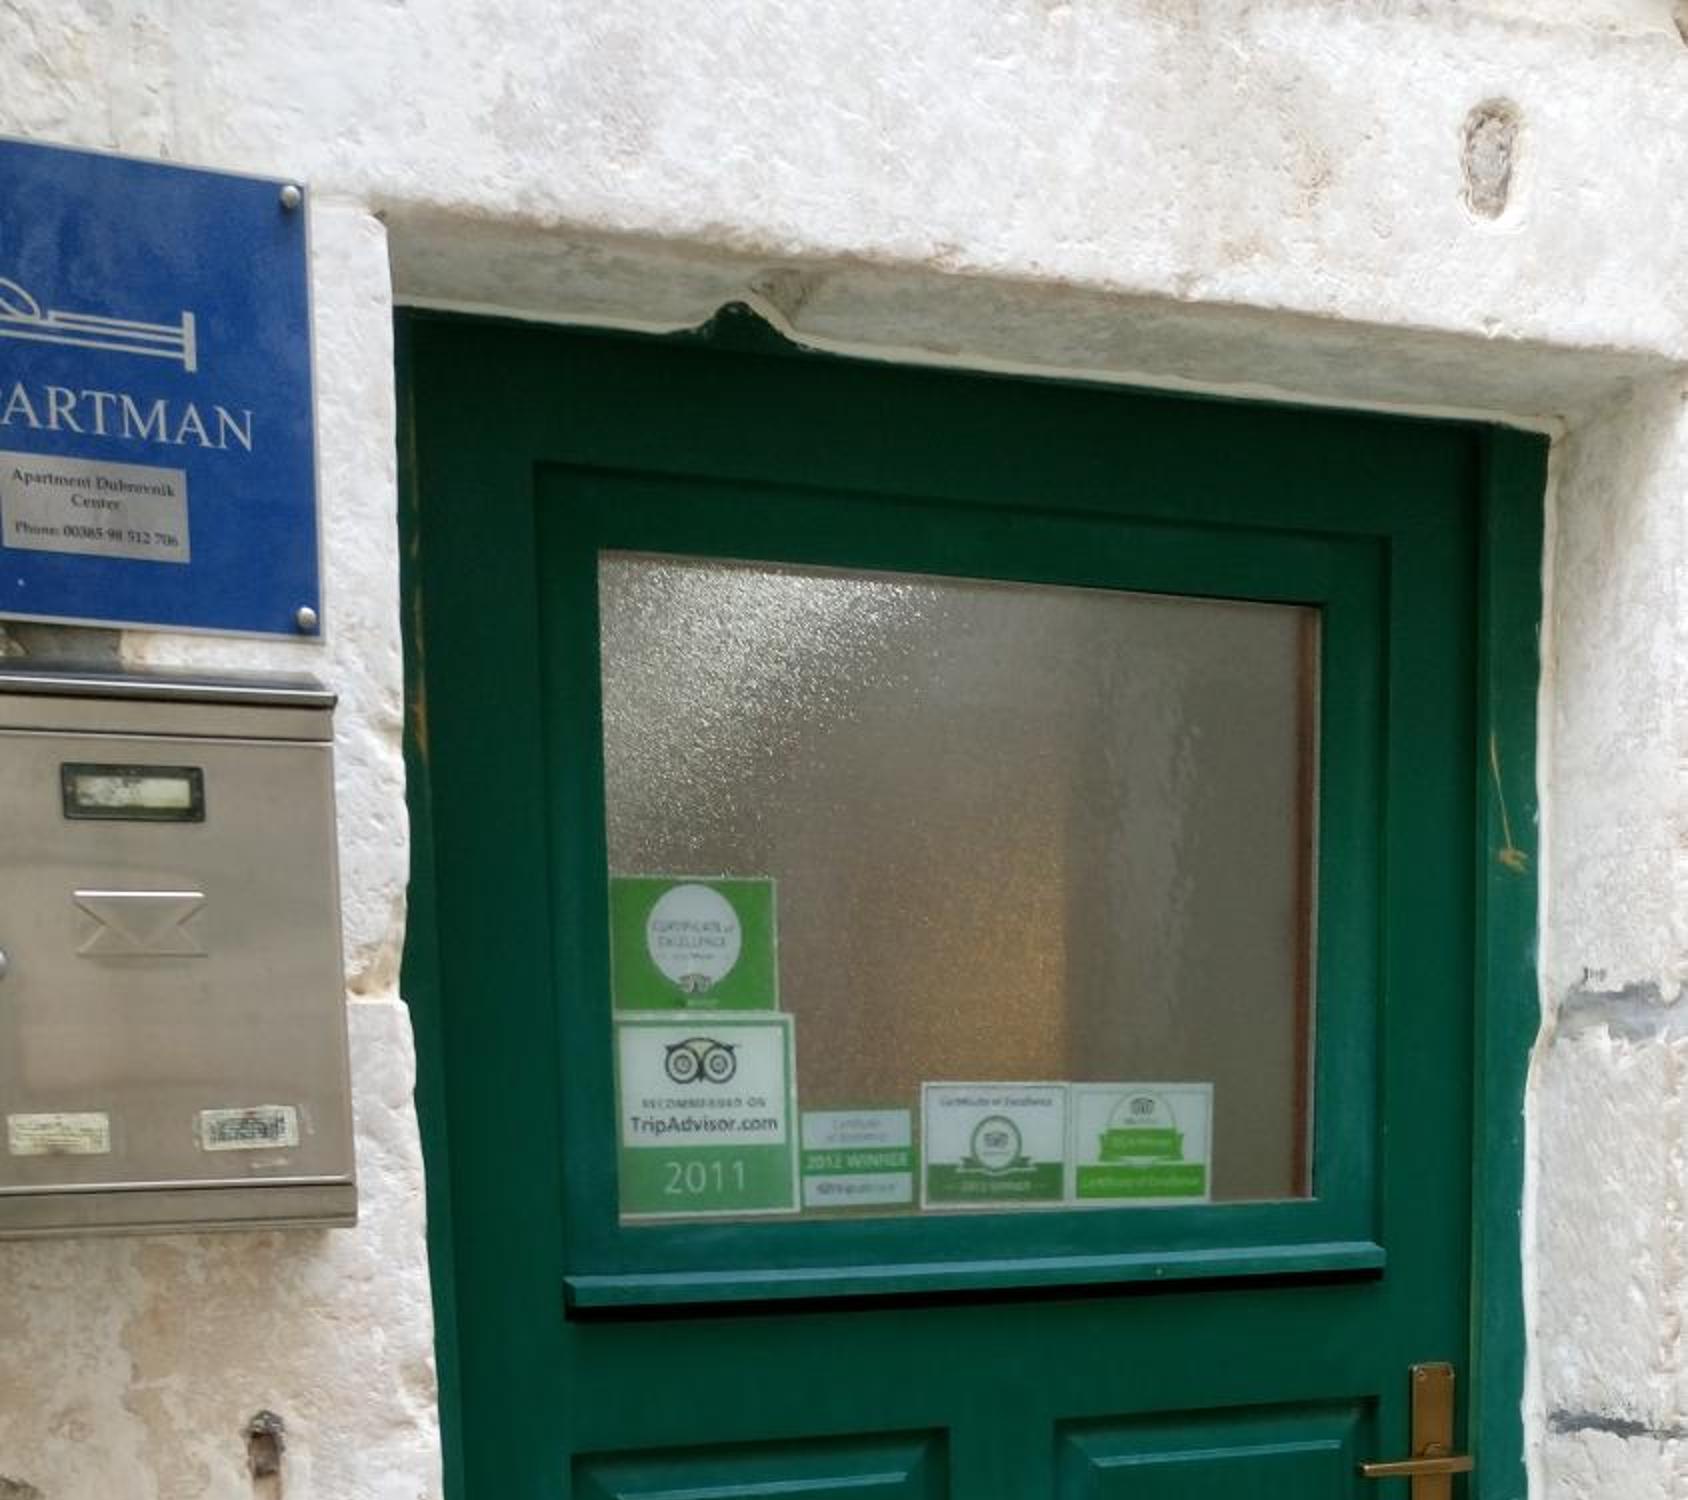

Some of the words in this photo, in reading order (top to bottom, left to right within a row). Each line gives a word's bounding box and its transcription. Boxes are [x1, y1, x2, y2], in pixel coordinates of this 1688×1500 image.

[0, 380, 253, 451] ARTMAN
[13, 467, 91, 489] Apartment
[95, 475, 175, 497] Dubrovnik
[631, 1115, 778, 1136] TripAdvisor.com
[663, 1160, 745, 1195] 2011
